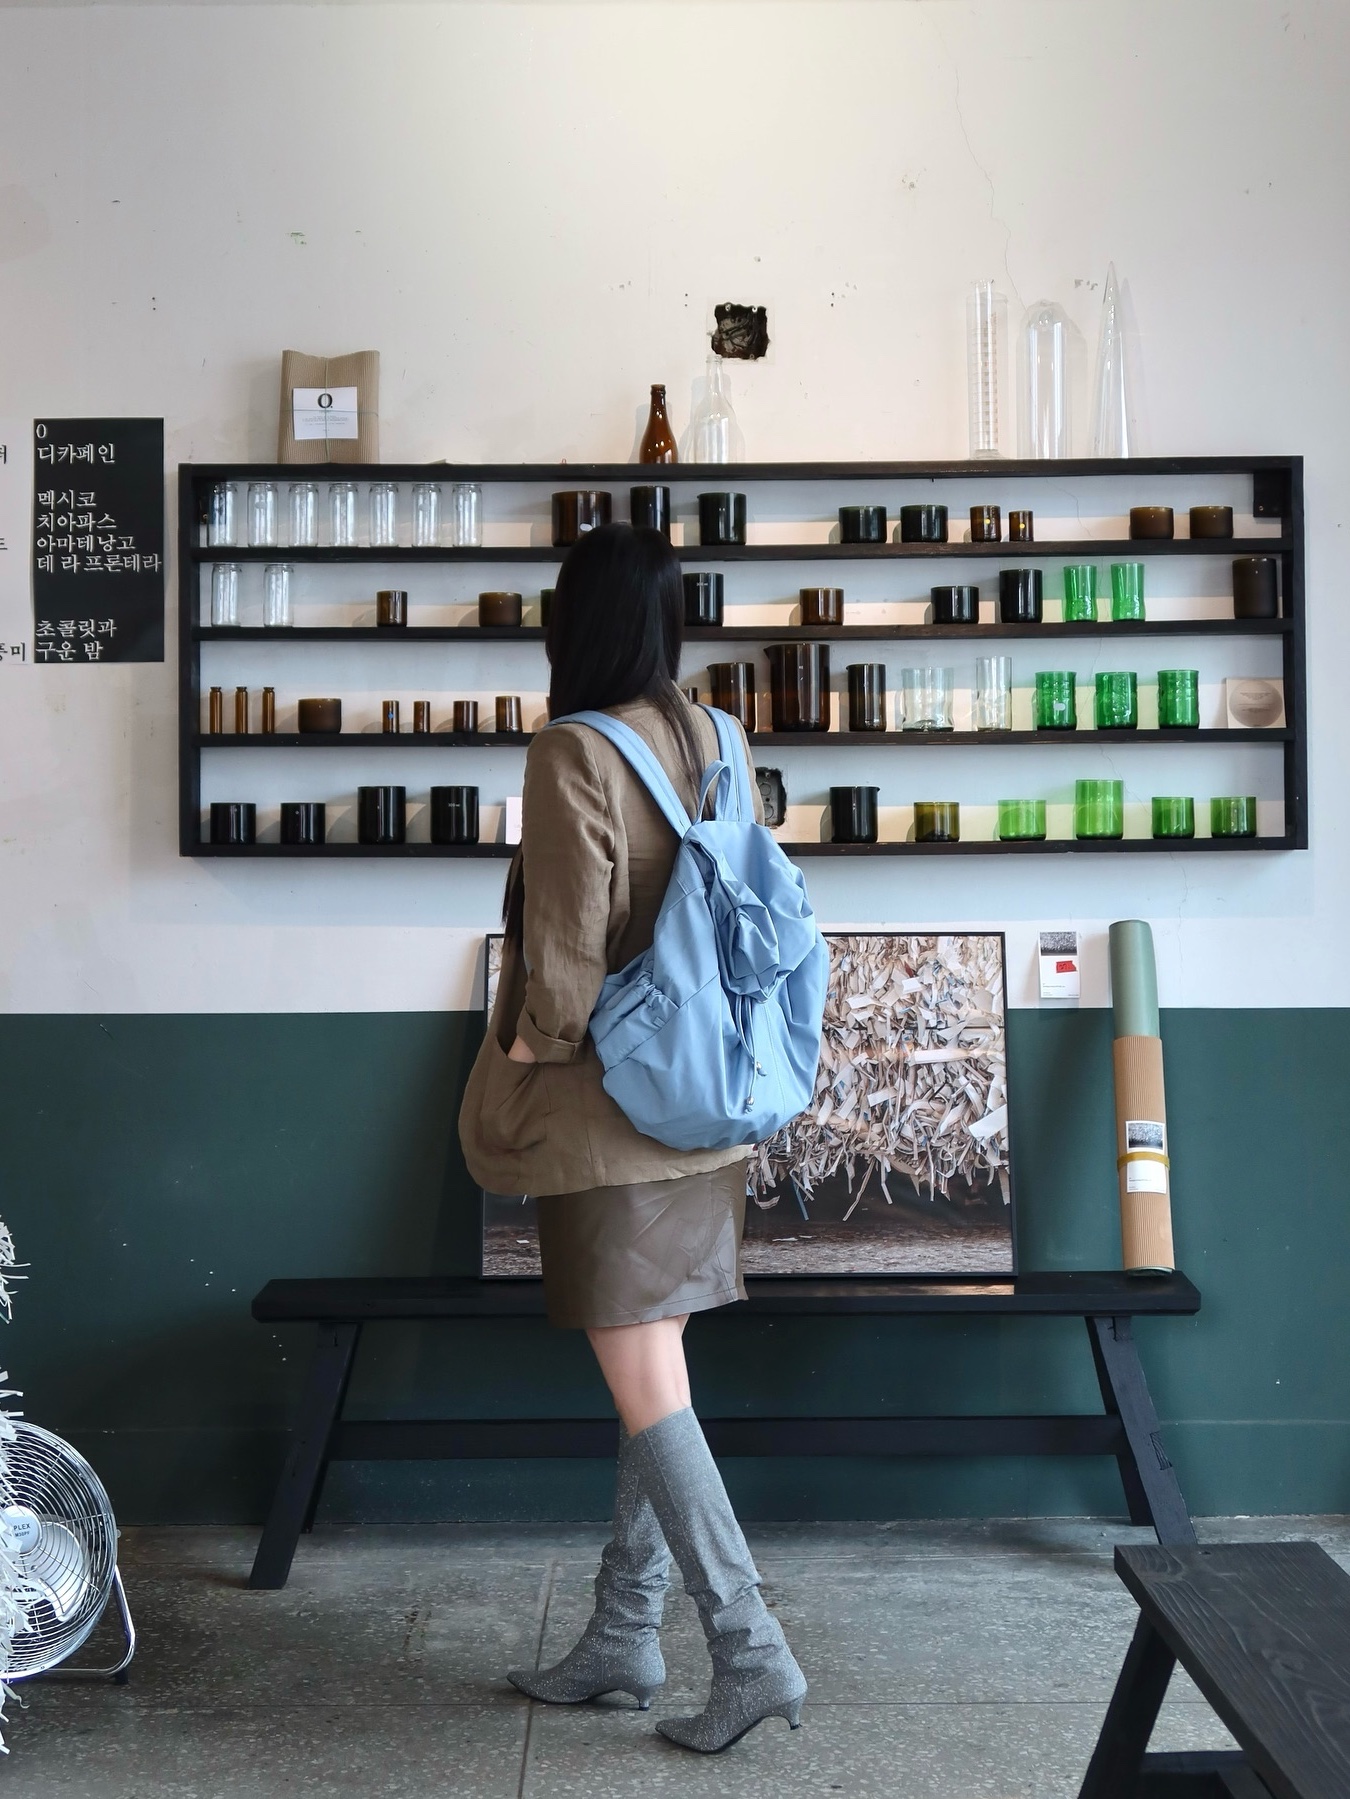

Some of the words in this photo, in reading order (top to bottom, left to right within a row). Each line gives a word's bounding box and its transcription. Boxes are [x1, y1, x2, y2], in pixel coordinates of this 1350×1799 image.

[37, 443, 116, 465] 디카페인
[37, 489, 97, 510] 멕시코
[36, 512, 117, 532] 치아파스
[36, 533, 136, 553] 아마테낭고
[36, 554, 55, 573] 데
[61, 554, 81, 574] 라
[83, 553, 162, 573] 프론테라
[35, 618, 118, 638] 초콜릿과
[35, 640, 77, 661] 구운
[83, 640, 104, 661] 밤
